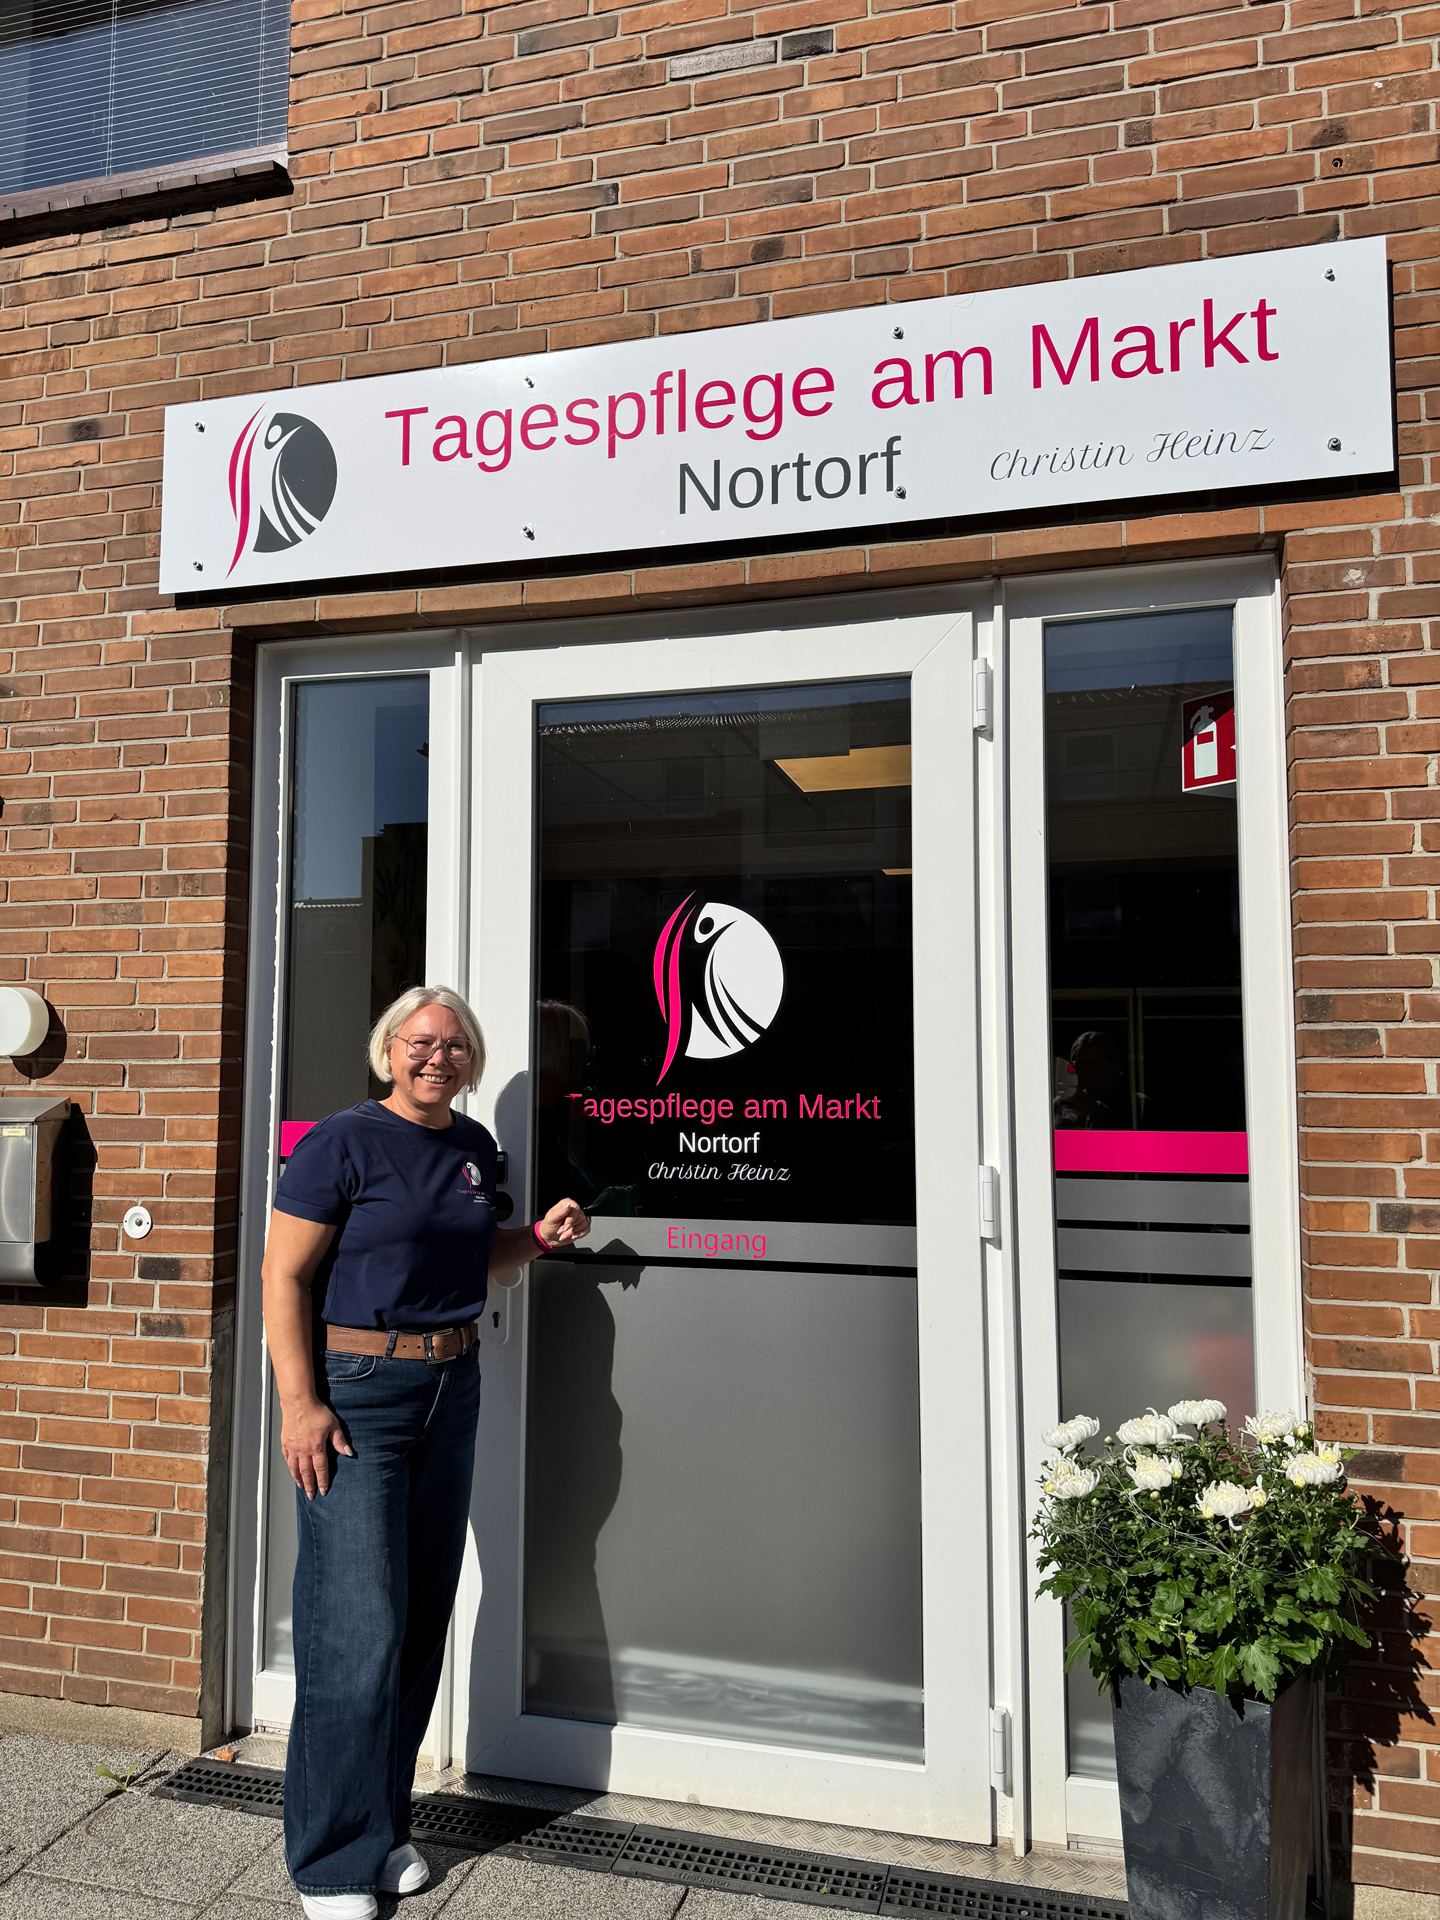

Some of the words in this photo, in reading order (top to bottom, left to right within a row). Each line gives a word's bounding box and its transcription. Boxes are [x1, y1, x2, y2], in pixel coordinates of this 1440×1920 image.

[385, 367, 835, 473] Tagespflege
[871, 346, 994, 409] am
[1032, 298, 1280, 389] Markt
[990, 441, 1134, 481] Christin
[1146, 428, 1275, 463] Heinz
[679, 435, 902, 515] Nortorf
[564, 1092, 734, 1125] Tagespflege
[743, 1099, 787, 1119] am
[799, 1093, 882, 1120] Markt
[679, 1131, 760, 1154] Nortorf
[648, 1161, 722, 1180] Christin
[727, 1163, 791, 1181] Heinz
[667, 1226, 767, 1259] Eingang
